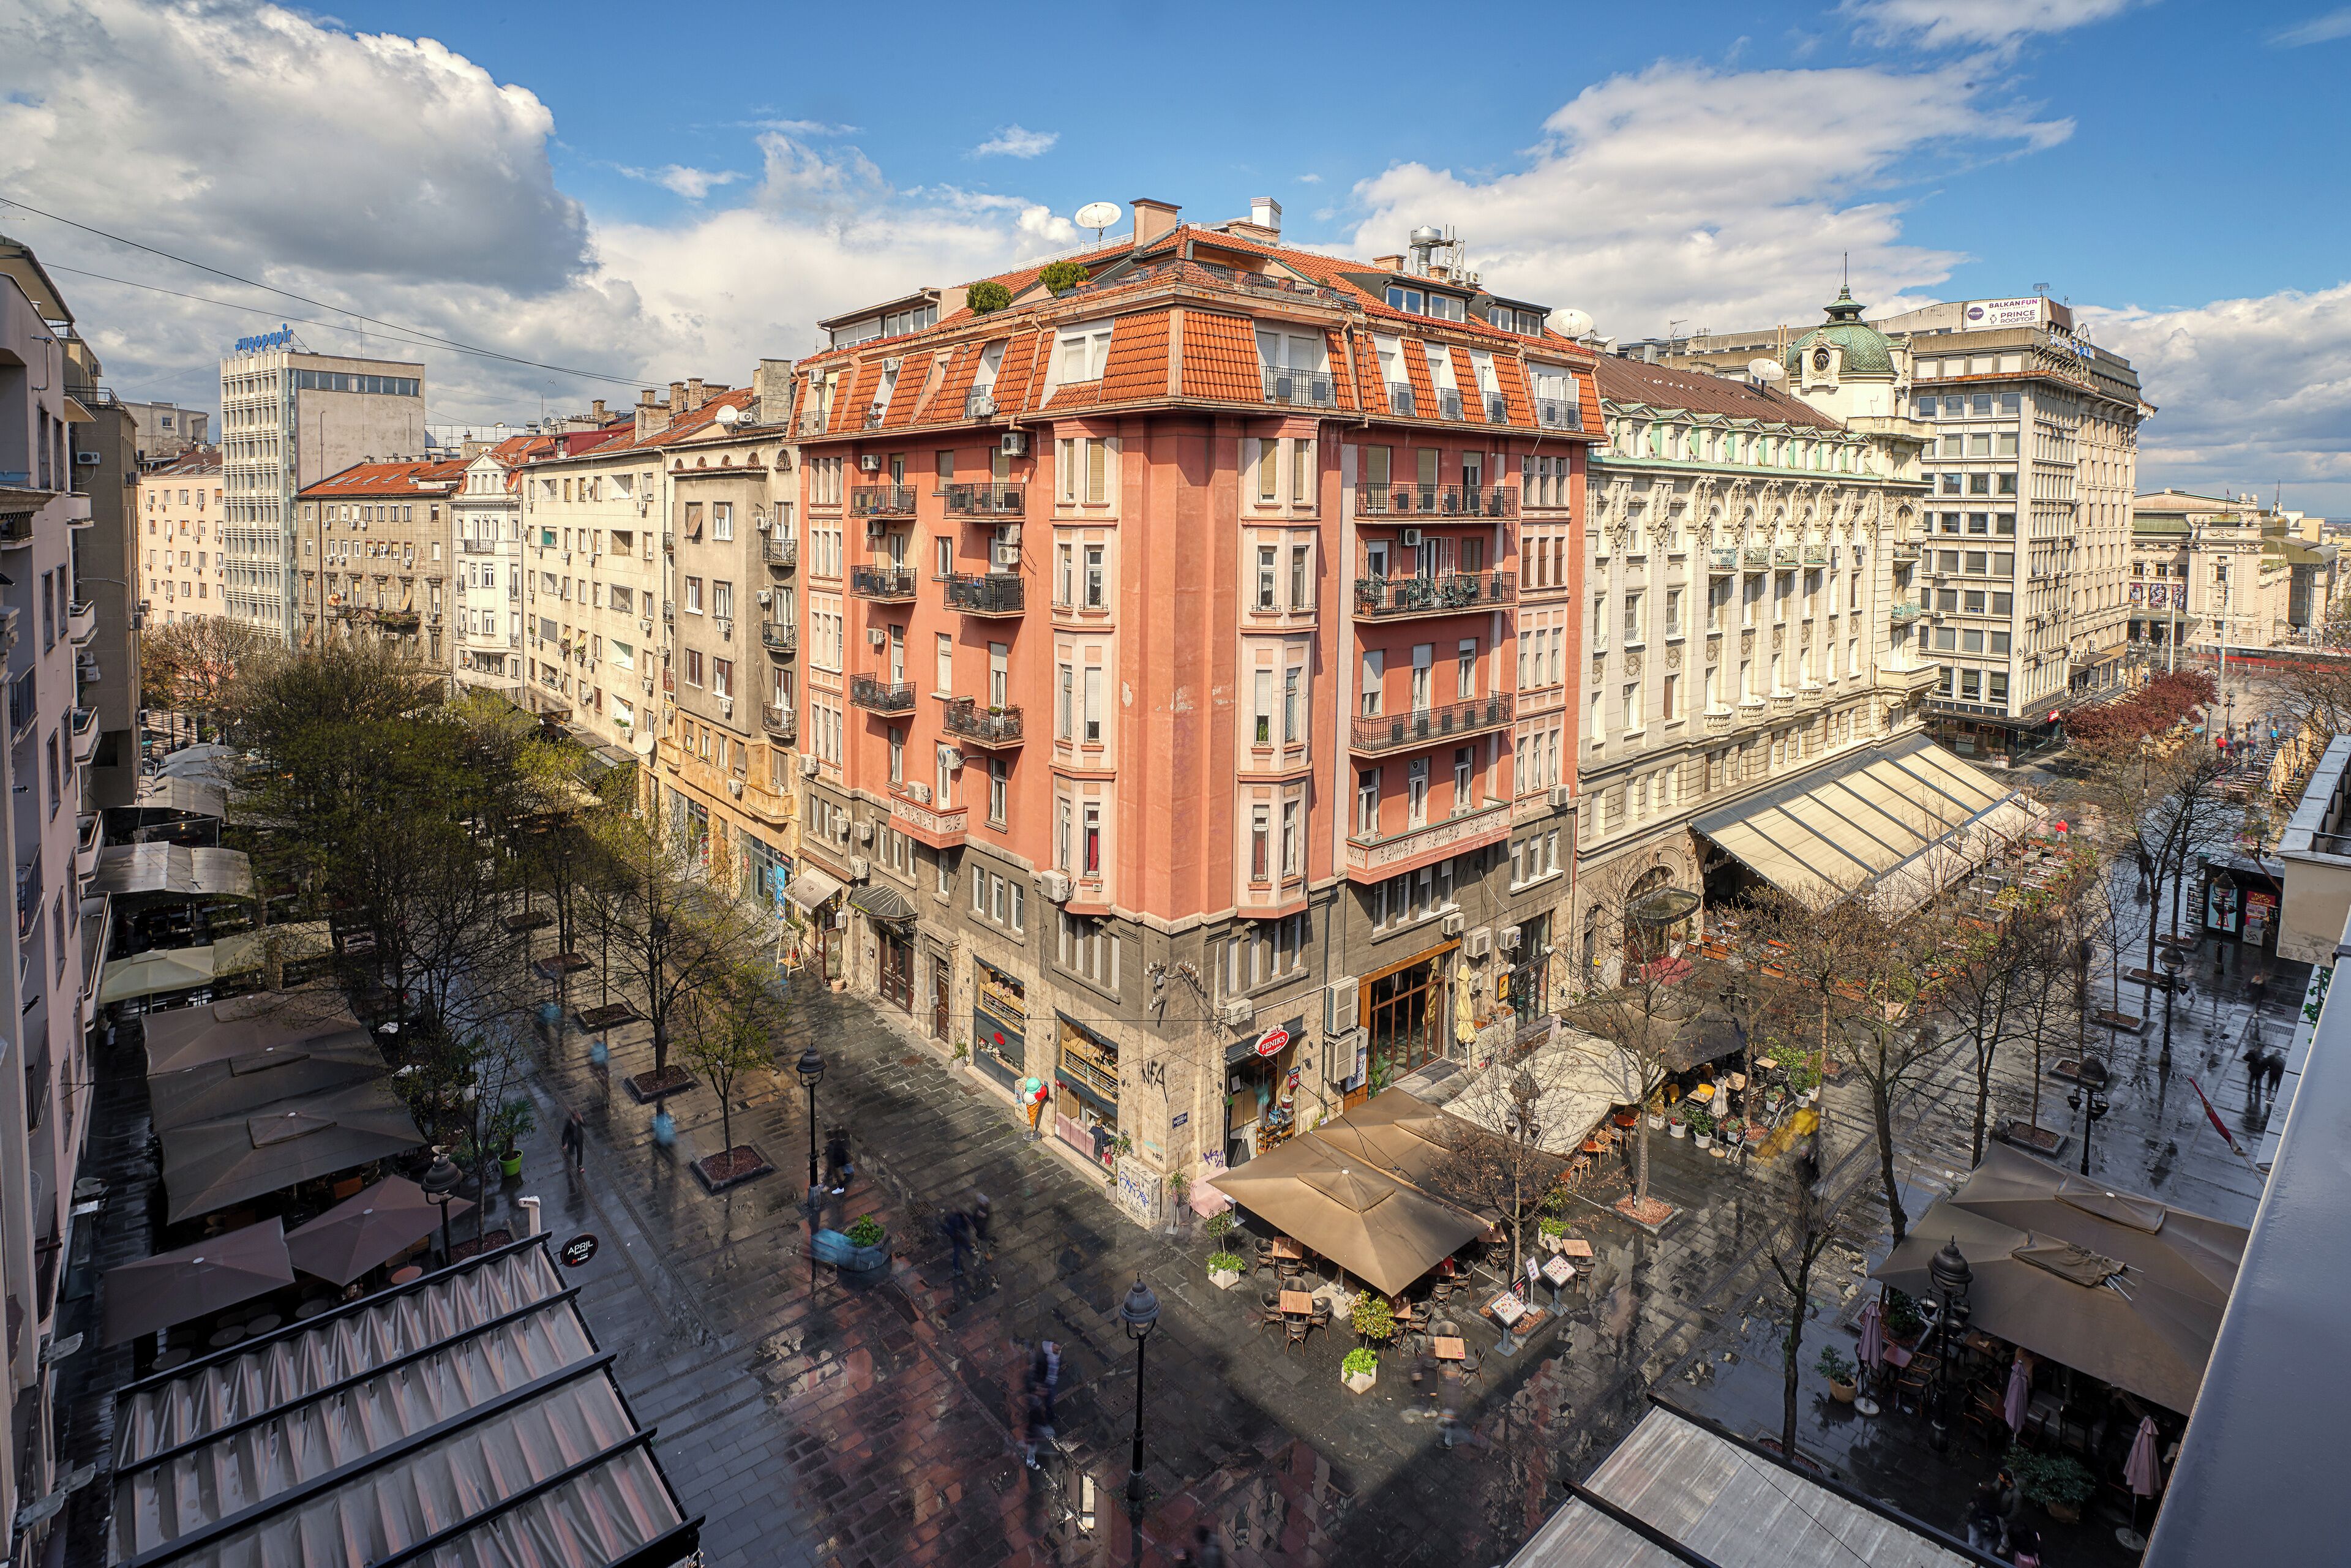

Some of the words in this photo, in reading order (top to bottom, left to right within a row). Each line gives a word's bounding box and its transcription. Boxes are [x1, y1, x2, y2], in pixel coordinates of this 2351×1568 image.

[2000, 310, 2035, 318] PRINCE
[1261, 1035, 1285, 1052] FENIKS
[1141, 1060, 1168, 1104] NFA
[1152, 1152, 1164, 1163] NFA
[567, 1240, 594, 1255] APRIL
